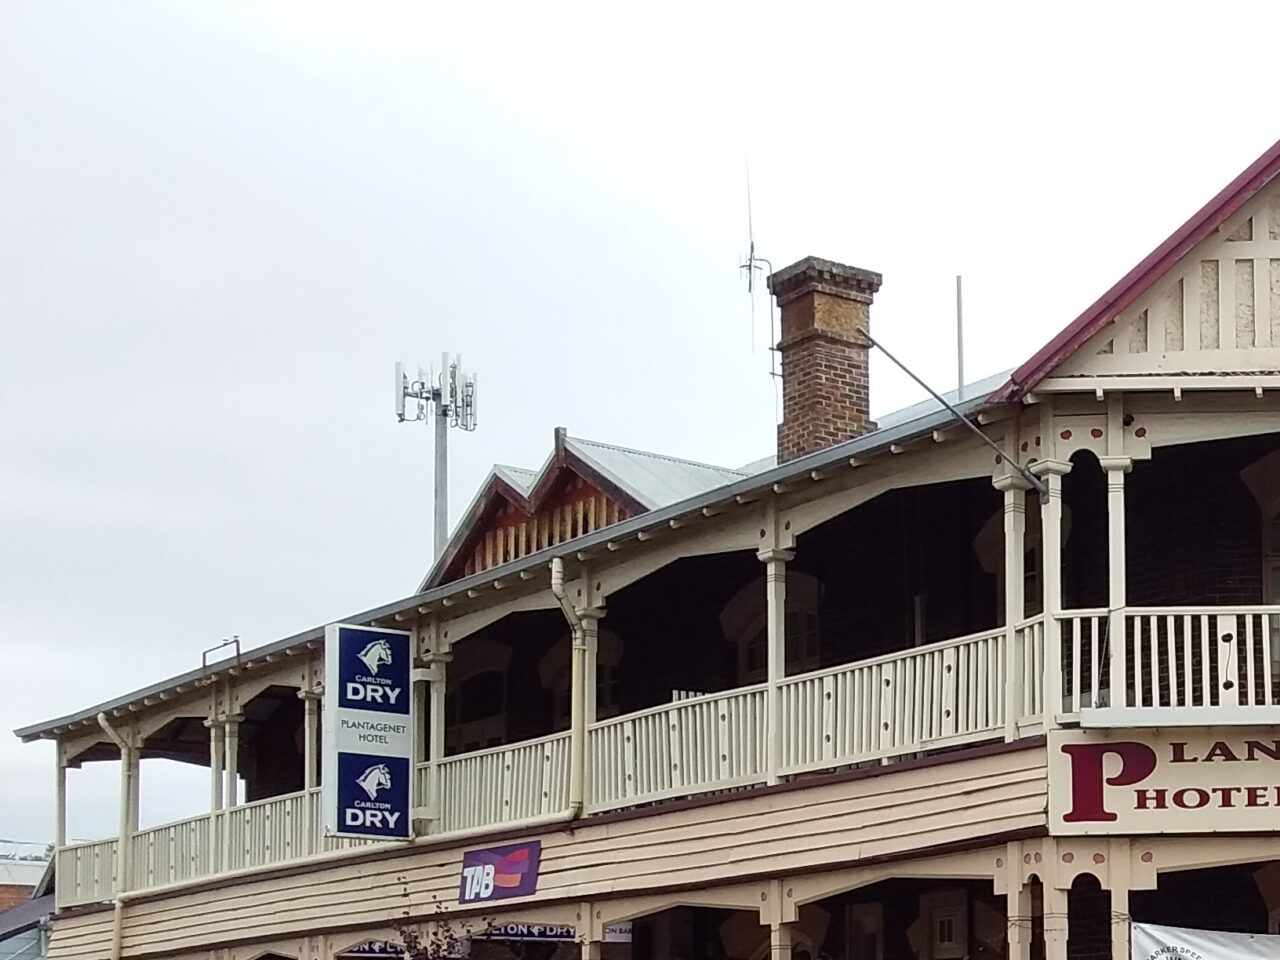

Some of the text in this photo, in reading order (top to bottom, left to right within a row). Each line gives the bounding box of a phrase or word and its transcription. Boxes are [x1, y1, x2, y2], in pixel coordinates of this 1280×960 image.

[355, 675, 392, 685] CARLTON
[346, 682, 402, 704] DRY
[341, 719, 406, 734] PLANTAGENET
[358, 733, 389, 744] HOTEL
[354, 800, 391, 810] CARLTON
[345, 808, 401, 829] DRY
[463, 864, 495, 900] TAB
[546, 926, 575, 936] DRY
